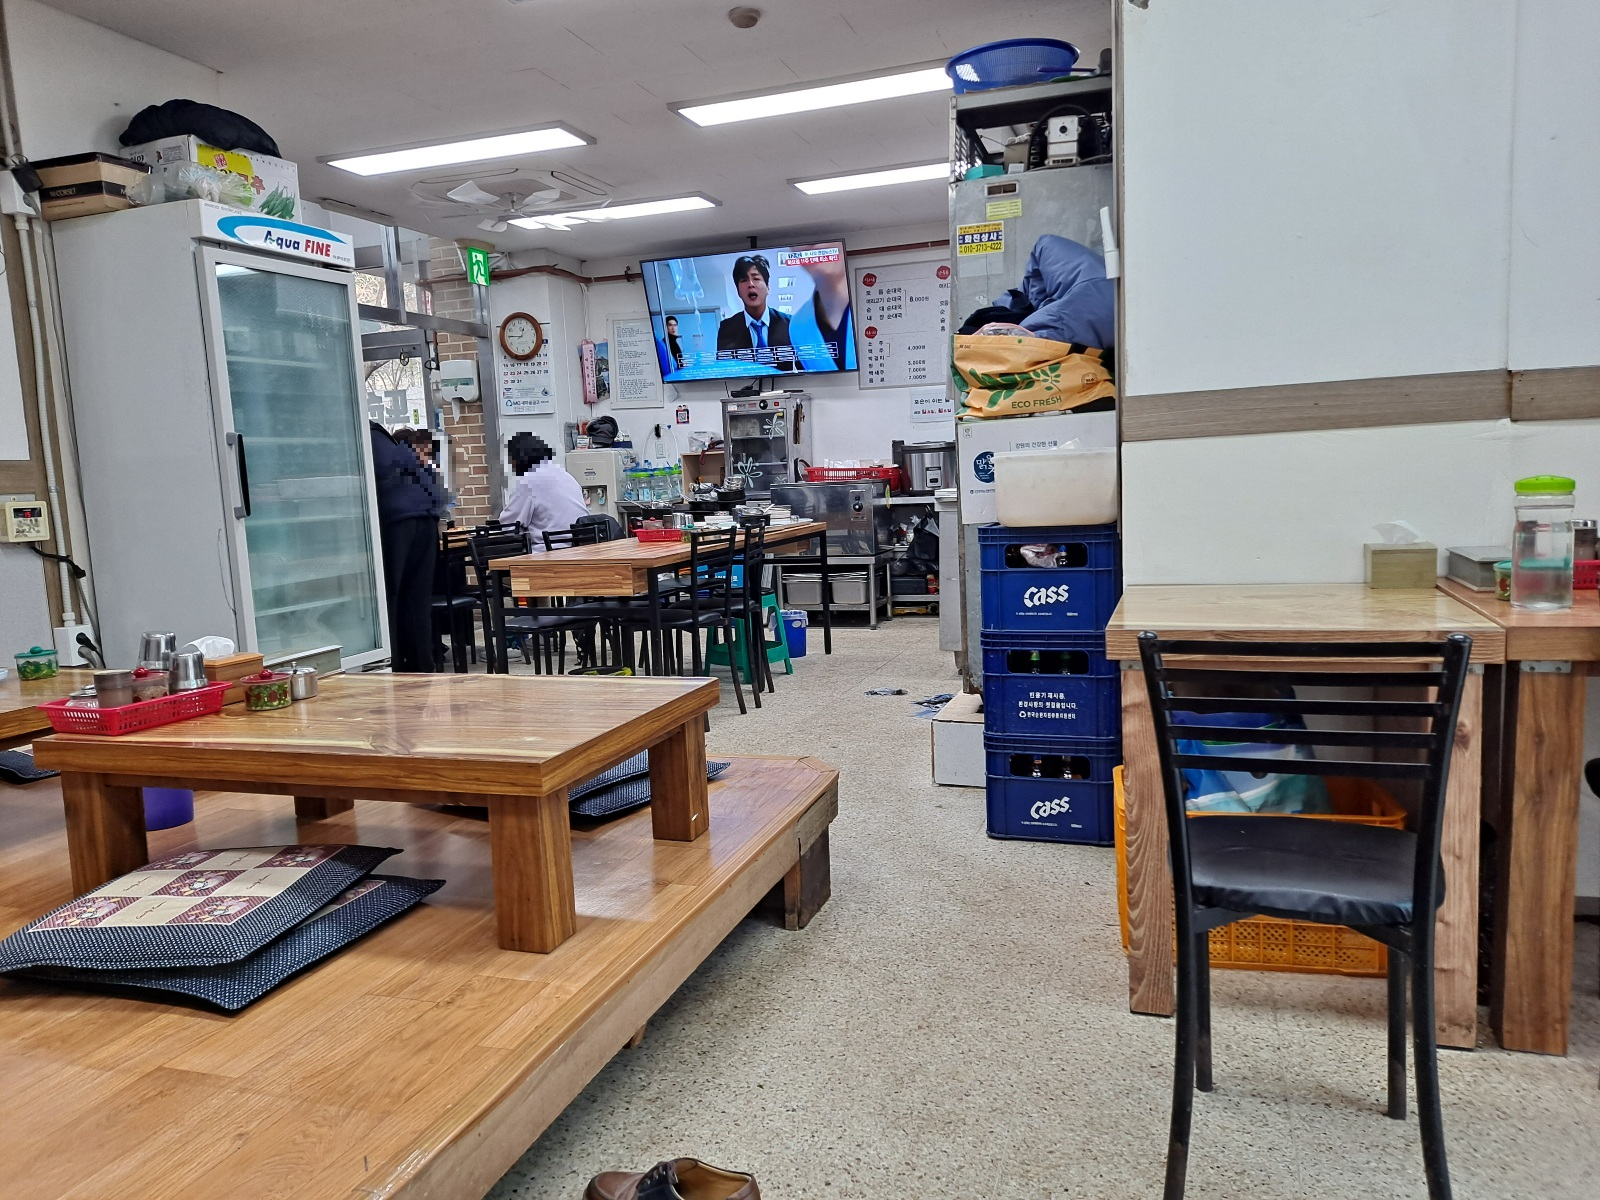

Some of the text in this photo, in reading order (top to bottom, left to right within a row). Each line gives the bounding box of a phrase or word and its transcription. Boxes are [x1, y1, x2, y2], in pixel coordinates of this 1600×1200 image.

[263, 230, 332, 257] Aqua FINE
[963, 242, 1002, 253] 010-3713-4222
[1012, 395, 1062, 409] ECO FRESH
[1023, 584, 1070, 608] Cass
[1030, 796, 1070, 820] Cass
